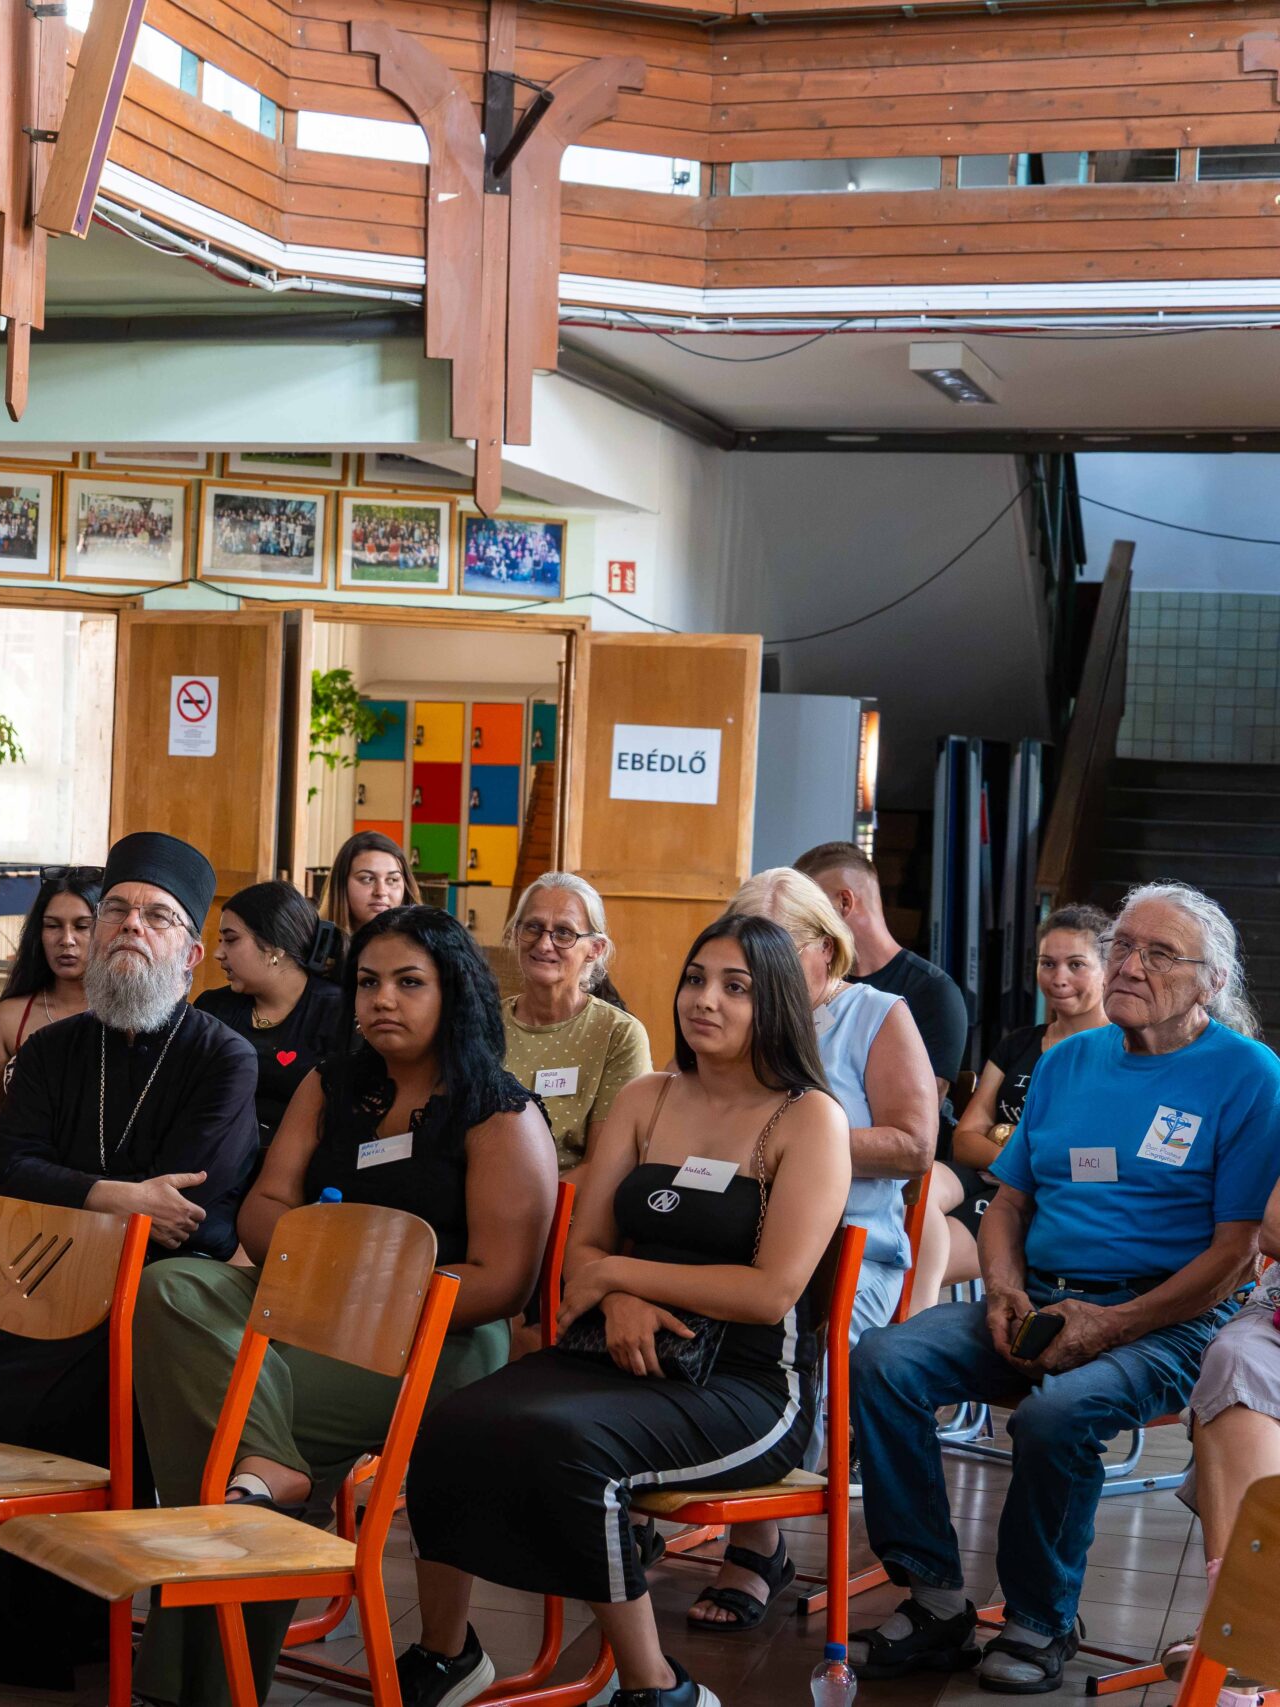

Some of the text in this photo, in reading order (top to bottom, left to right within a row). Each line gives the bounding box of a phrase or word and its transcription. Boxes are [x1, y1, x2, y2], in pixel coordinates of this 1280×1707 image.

[617, 748, 707, 774] EBÉDLŐ
[544, 1078, 566, 1088] RITA
[1078, 1156, 1100, 1168] LACI
